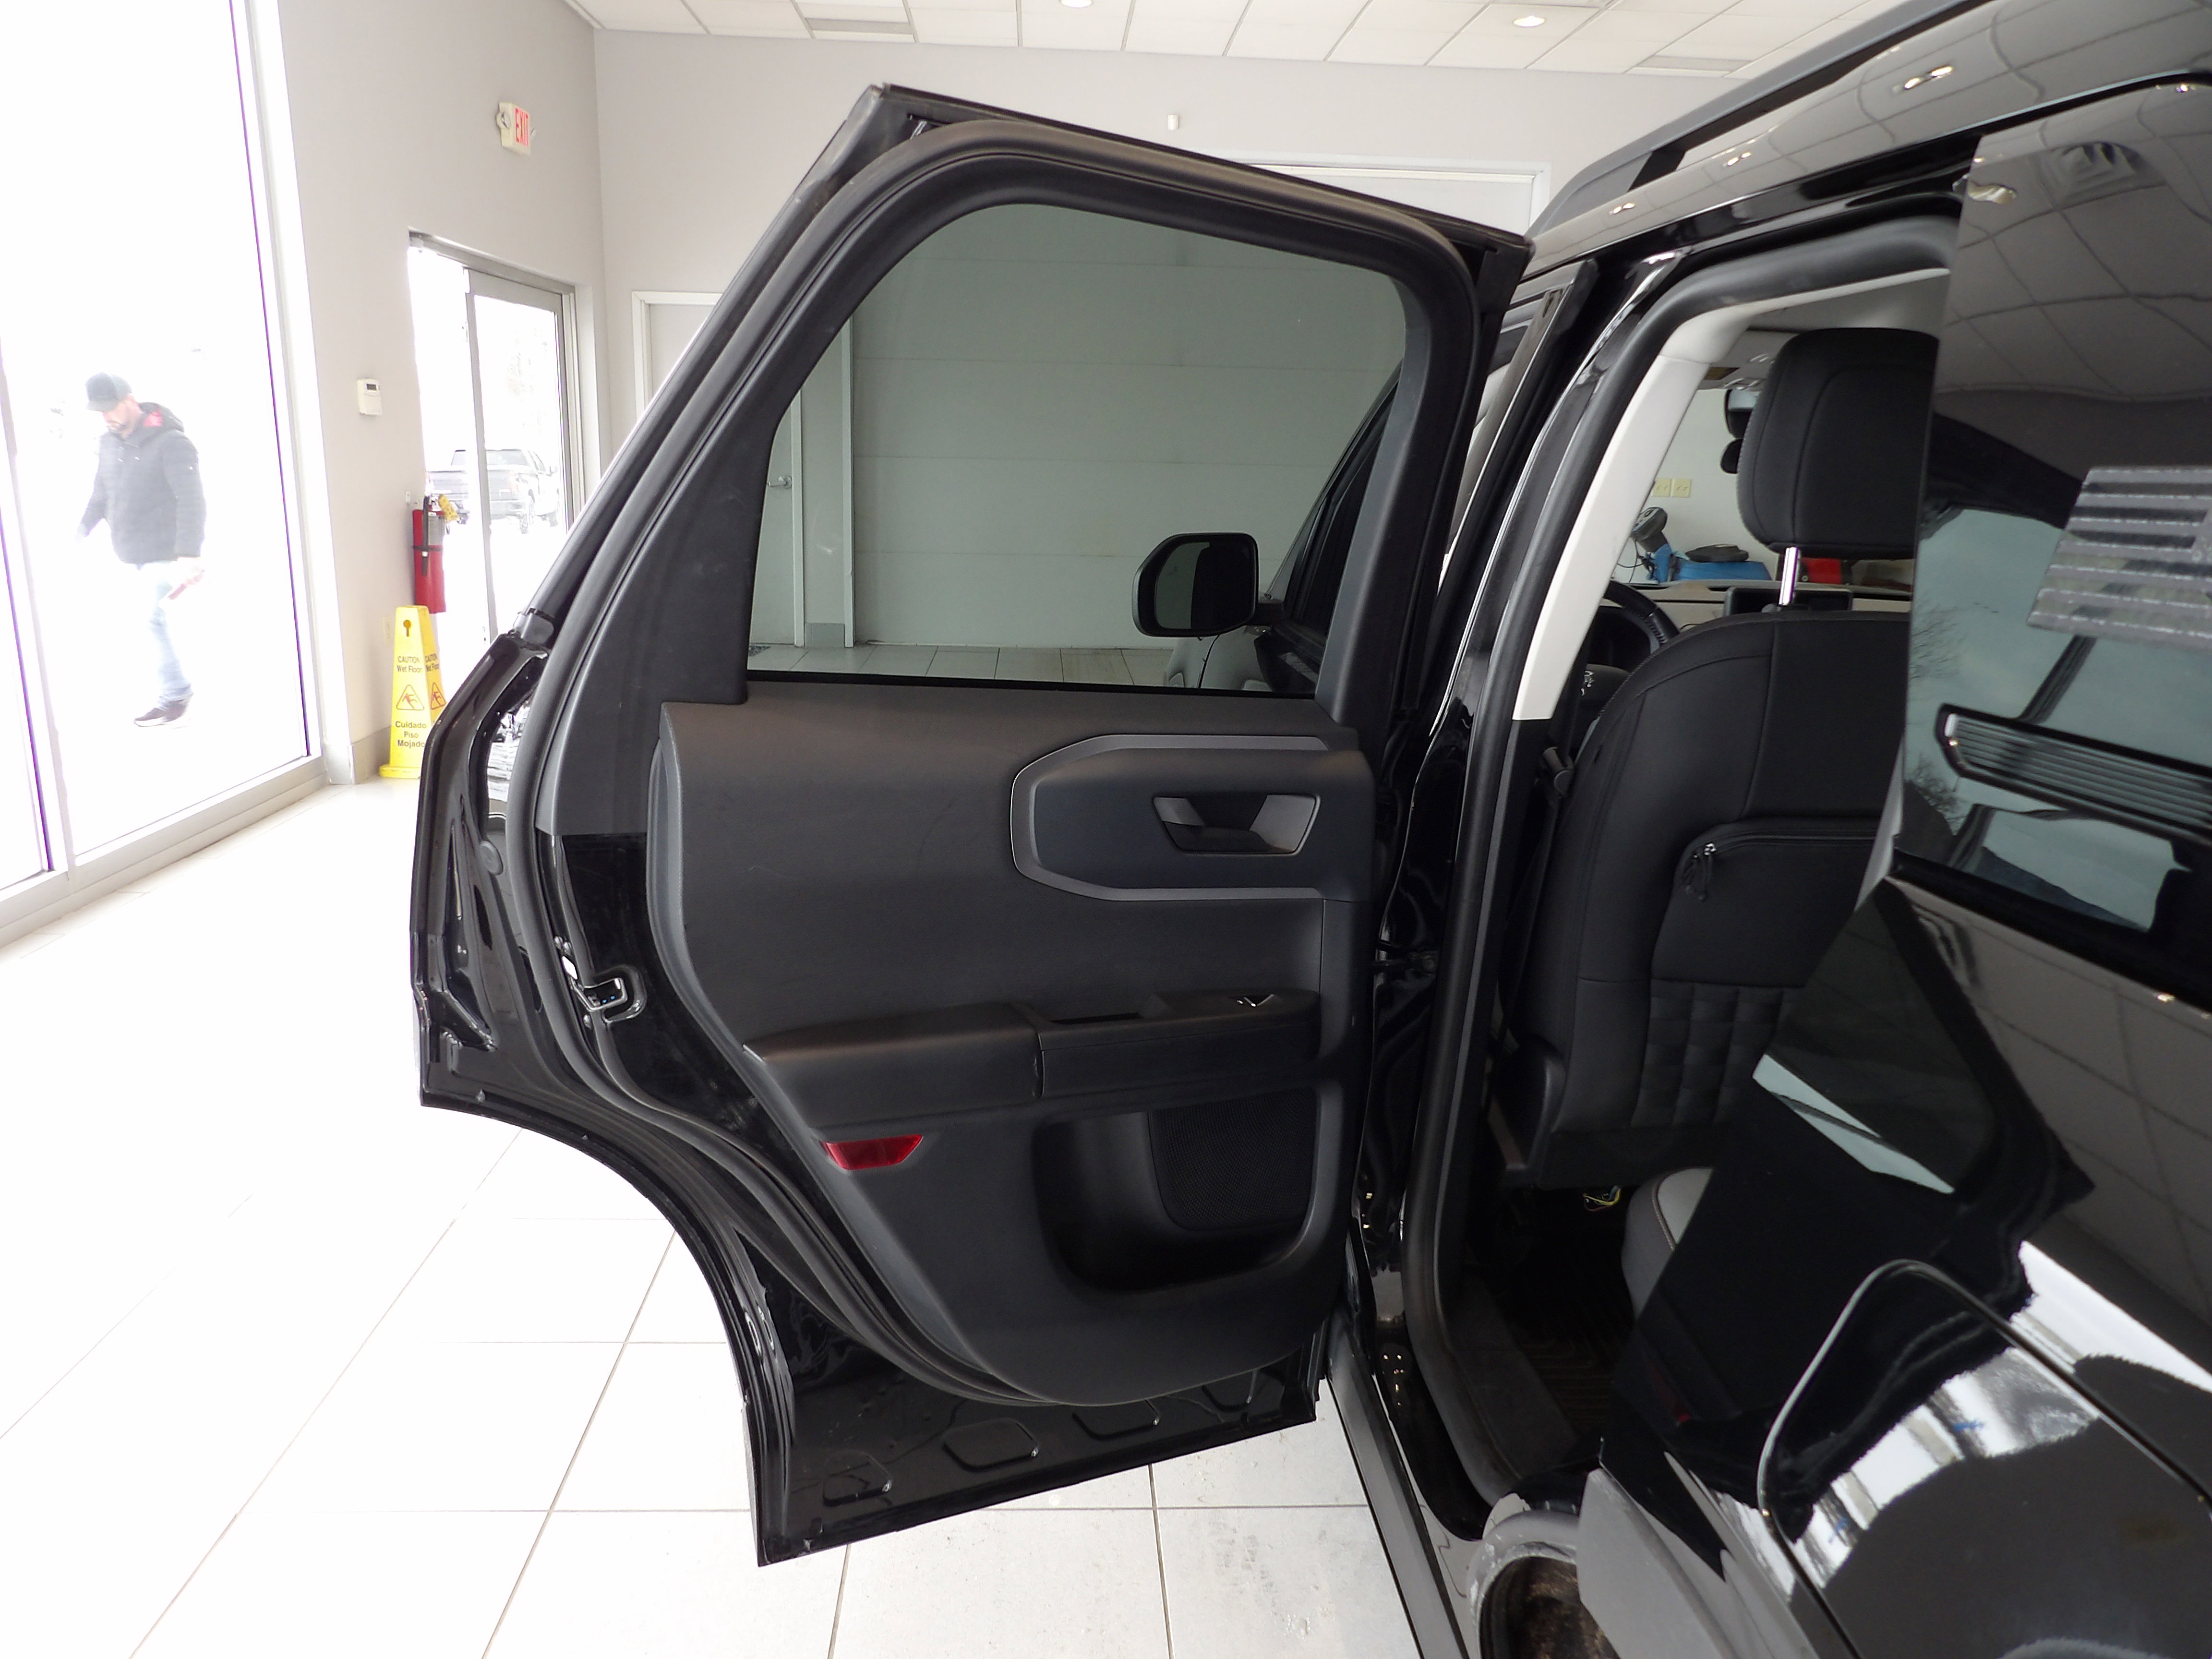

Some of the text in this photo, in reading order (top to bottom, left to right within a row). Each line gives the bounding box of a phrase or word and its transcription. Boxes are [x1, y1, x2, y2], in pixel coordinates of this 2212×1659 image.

[516, 107, 529, 147] EXIT
[397, 664, 407, 673] Wet
[397, 740, 425, 748] Mojado
